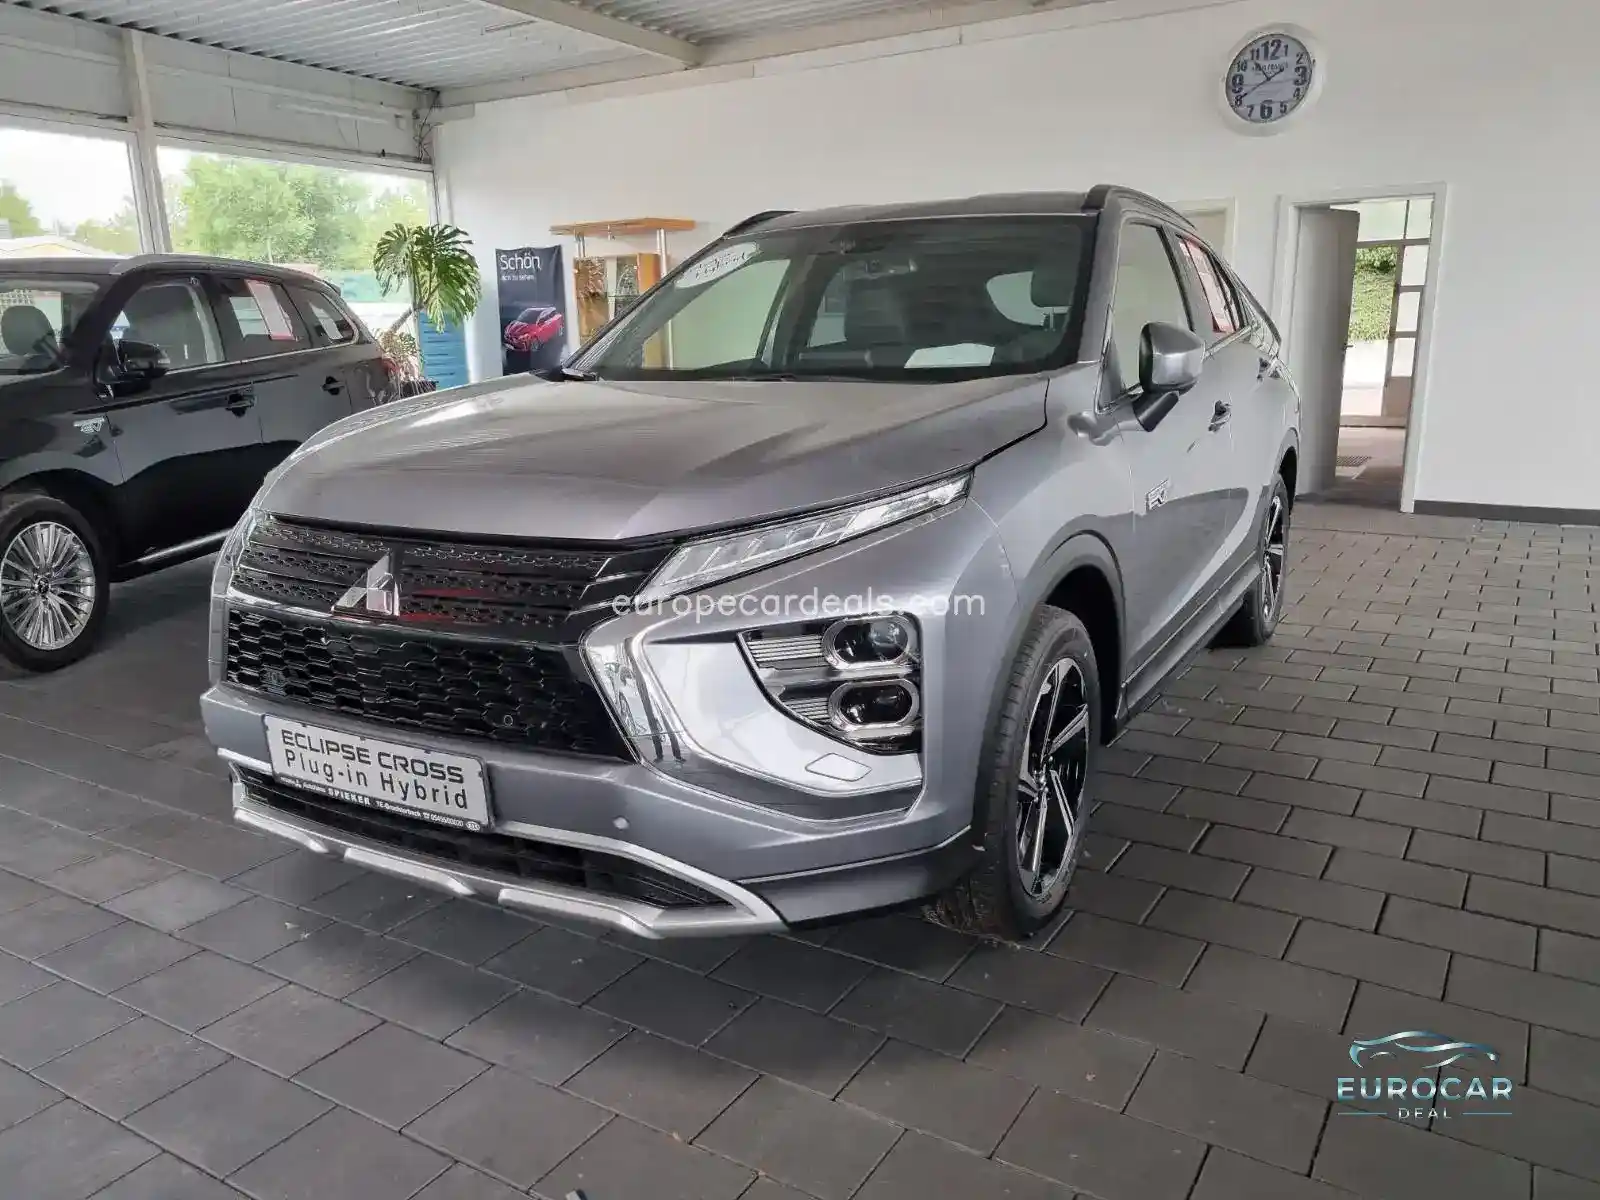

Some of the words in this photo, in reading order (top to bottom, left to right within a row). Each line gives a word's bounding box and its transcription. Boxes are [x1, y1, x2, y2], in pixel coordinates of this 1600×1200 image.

[1250, 48, 1260, 60] 11
[1261, 39, 1281, 60] 12
[1284, 44, 1289, 57] 1
[1237, 60, 1248, 72] 10
[1296, 52, 1304, 65] 2
[1231, 74, 1244, 94] 9
[1294, 66, 1307, 86] 3
[1293, 87, 1301, 100] 4
[1246, 104, 1255, 117] 7
[1260, 100, 1273, 119] 6
[1280, 101, 1288, 113] 5
[281, 729, 372, 766] ECLIPSE
[377, 751, 464, 785] CROSS
[285, 748, 368, 788] Plug-in
[380, 771, 468, 810] Hybrid
[328, 787, 371, 806] SPIEKER
